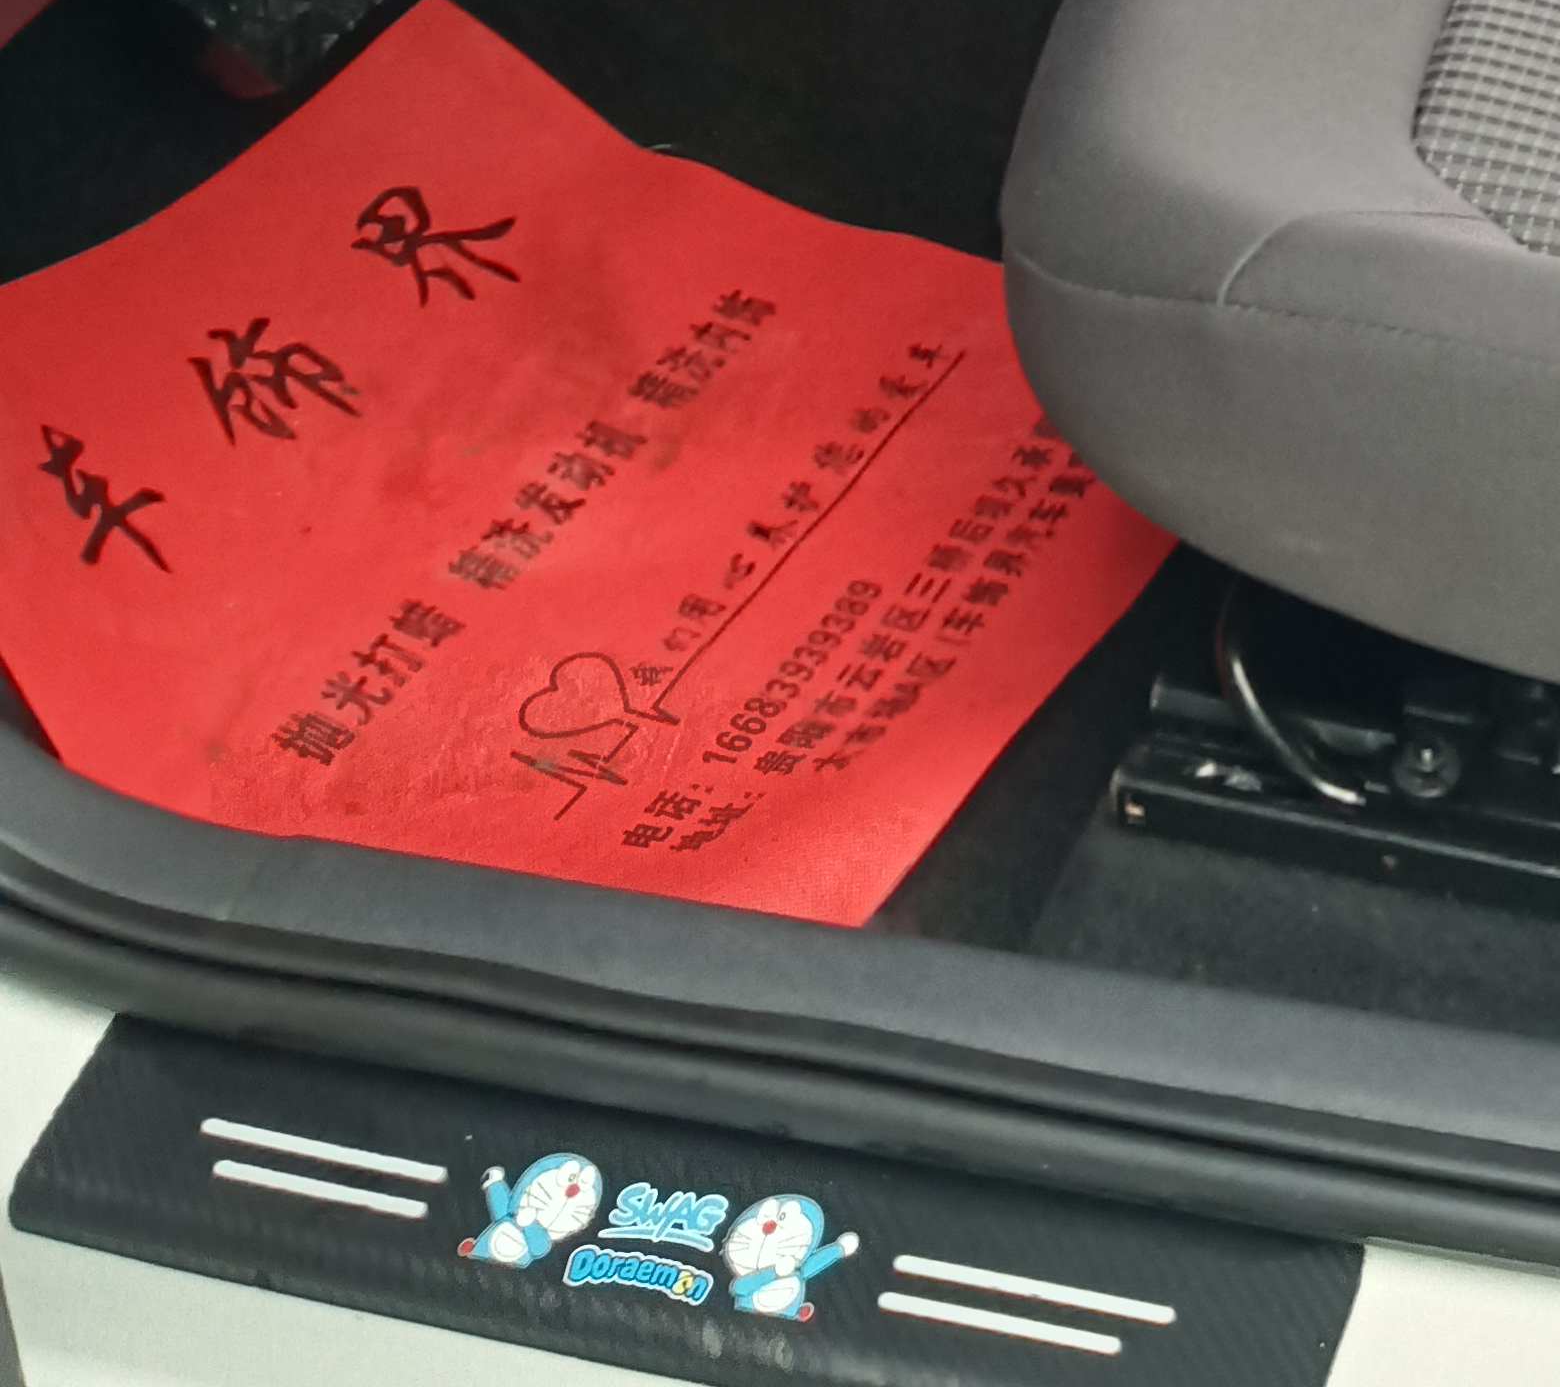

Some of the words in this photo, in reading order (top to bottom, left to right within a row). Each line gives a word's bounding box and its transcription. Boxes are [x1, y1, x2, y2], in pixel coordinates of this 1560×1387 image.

[271, 598, 467, 767] 抛光打蜡
[448, 419, 650, 590] 精洗发动机
[628, 288, 778, 410] 精洗内饰
[609, 1182, 729, 1239] SWAG
[565, 1246, 712, 1304] Doraemon
